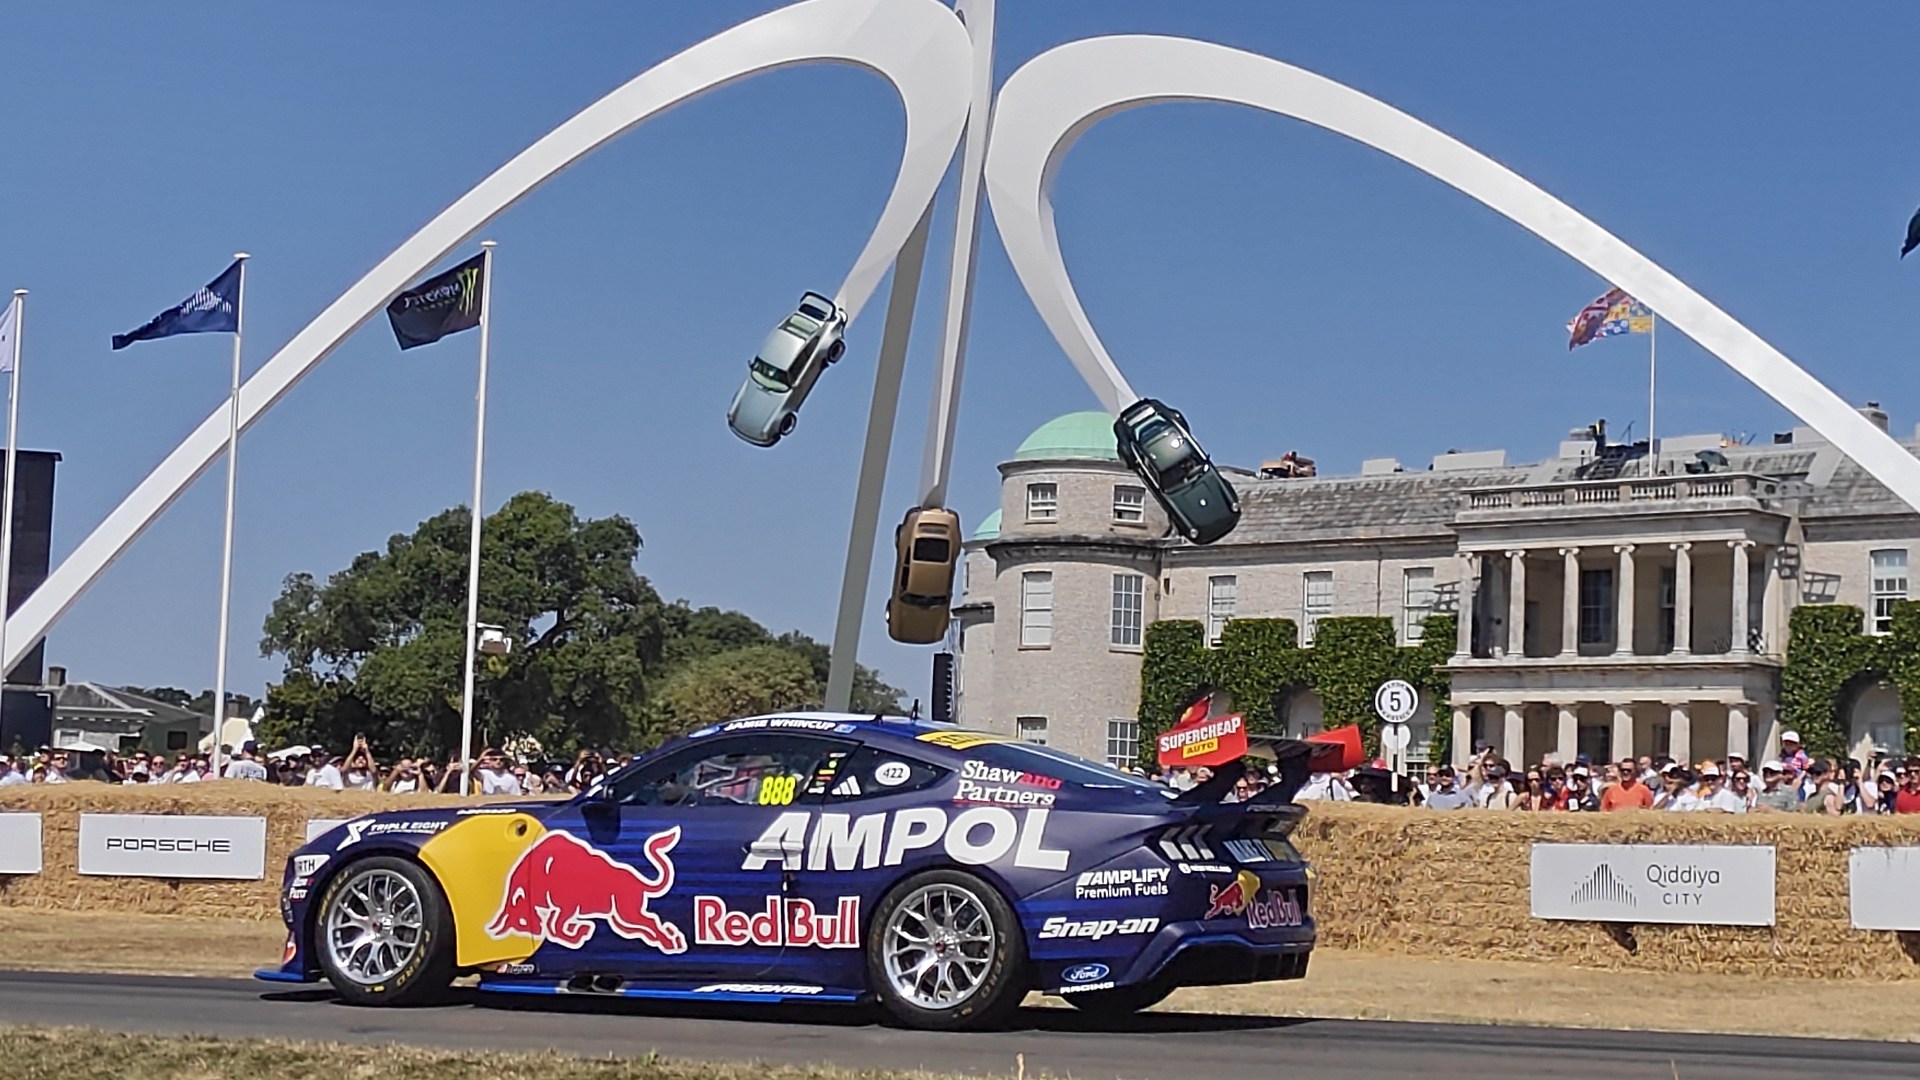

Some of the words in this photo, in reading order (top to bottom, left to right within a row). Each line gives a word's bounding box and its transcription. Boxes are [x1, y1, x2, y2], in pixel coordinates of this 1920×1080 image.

[1390, 691, 1401, 712] 5
[724, 719, 769, 731] JAMIE
[770, 718, 836, 731] WHINCUP
[1160, 717, 1241, 752] SUPERCHEAP
[1186, 741, 1215, 756] AUTO
[882, 766, 904, 780] 422
[759, 776, 797, 805] 888
[953, 779, 1056, 806] Partners
[370, 823, 407, 832] TRIPLE
[410, 821, 448, 830] EIGHT
[106, 838, 231, 852] PORSCHE
[741, 807, 1071, 871] AMPOL
[1091, 868, 1171, 885] AMPLIFY
[1646, 864, 1720, 889] Qiddiya
[1076, 885, 1131, 899] Premium
[1134, 883, 1168, 896] Fuels
[1662, 894, 1703, 905] CITY
[695, 896, 780, 944] Red
[786, 896, 860, 947] Bull
[1039, 917, 1160, 940] Snap-on
[1069, 966, 1100, 980] Ford
[1060, 981, 1115, 994] RACING
